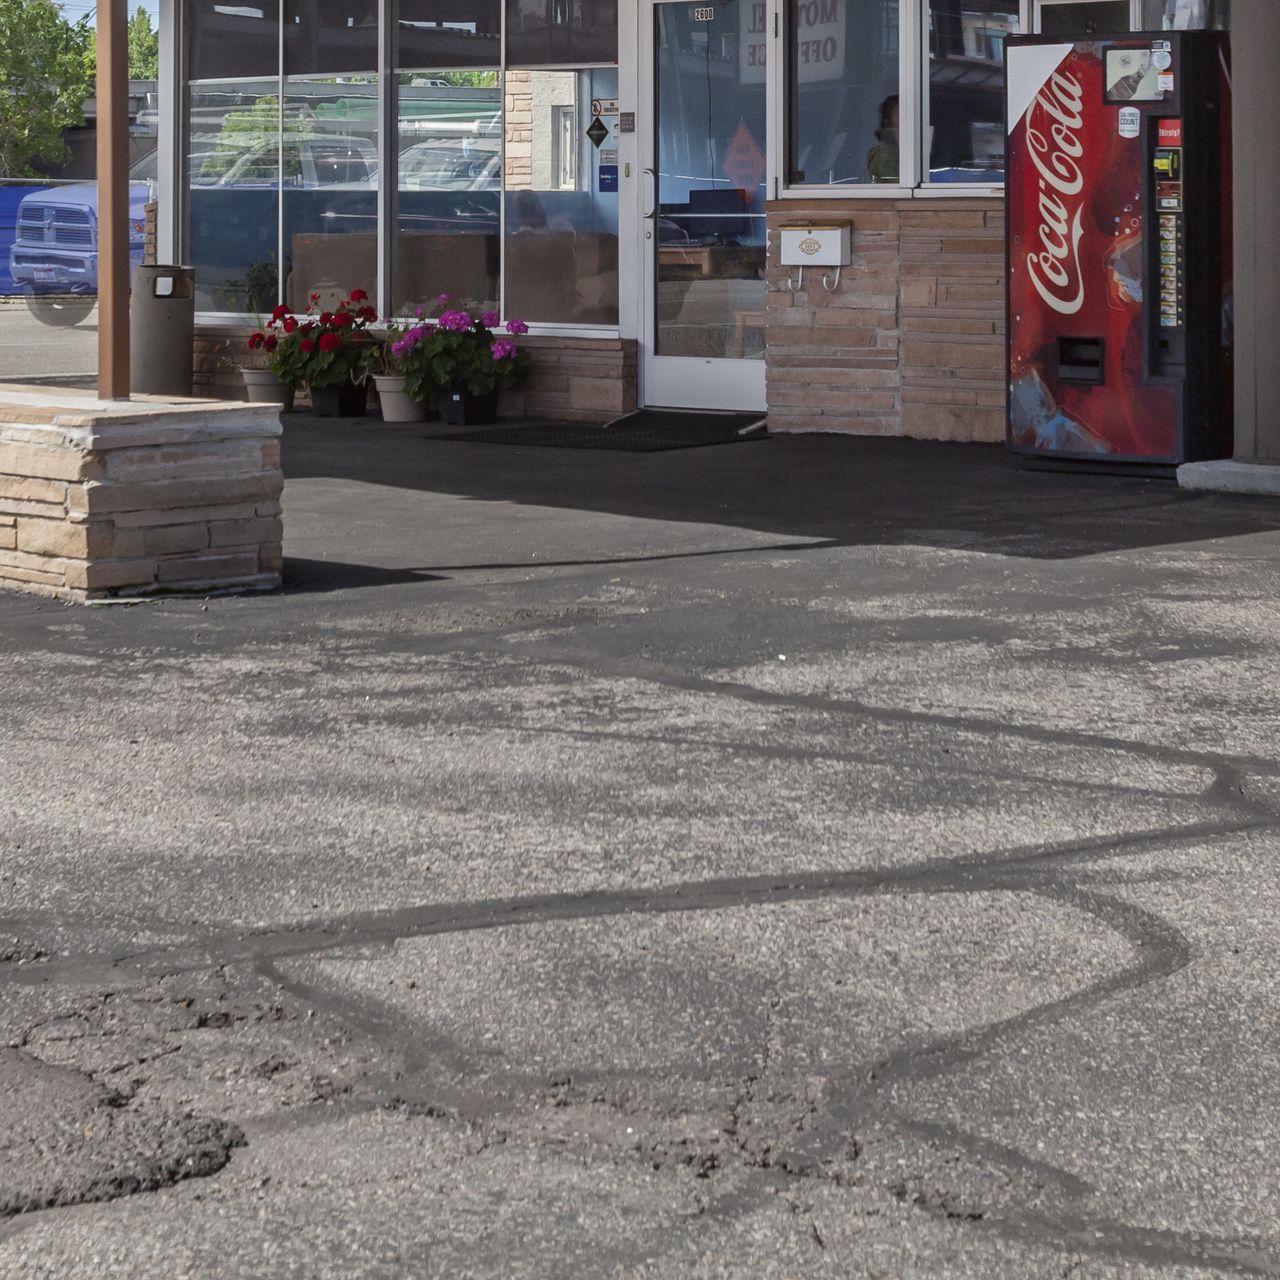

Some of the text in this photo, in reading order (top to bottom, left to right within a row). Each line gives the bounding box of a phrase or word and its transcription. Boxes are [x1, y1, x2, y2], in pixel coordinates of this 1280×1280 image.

[695, 8, 713, 20] 2600
[1120, 118, 1139, 126] COUNT
[1026, 70, 1085, 315] Coca-Cola
